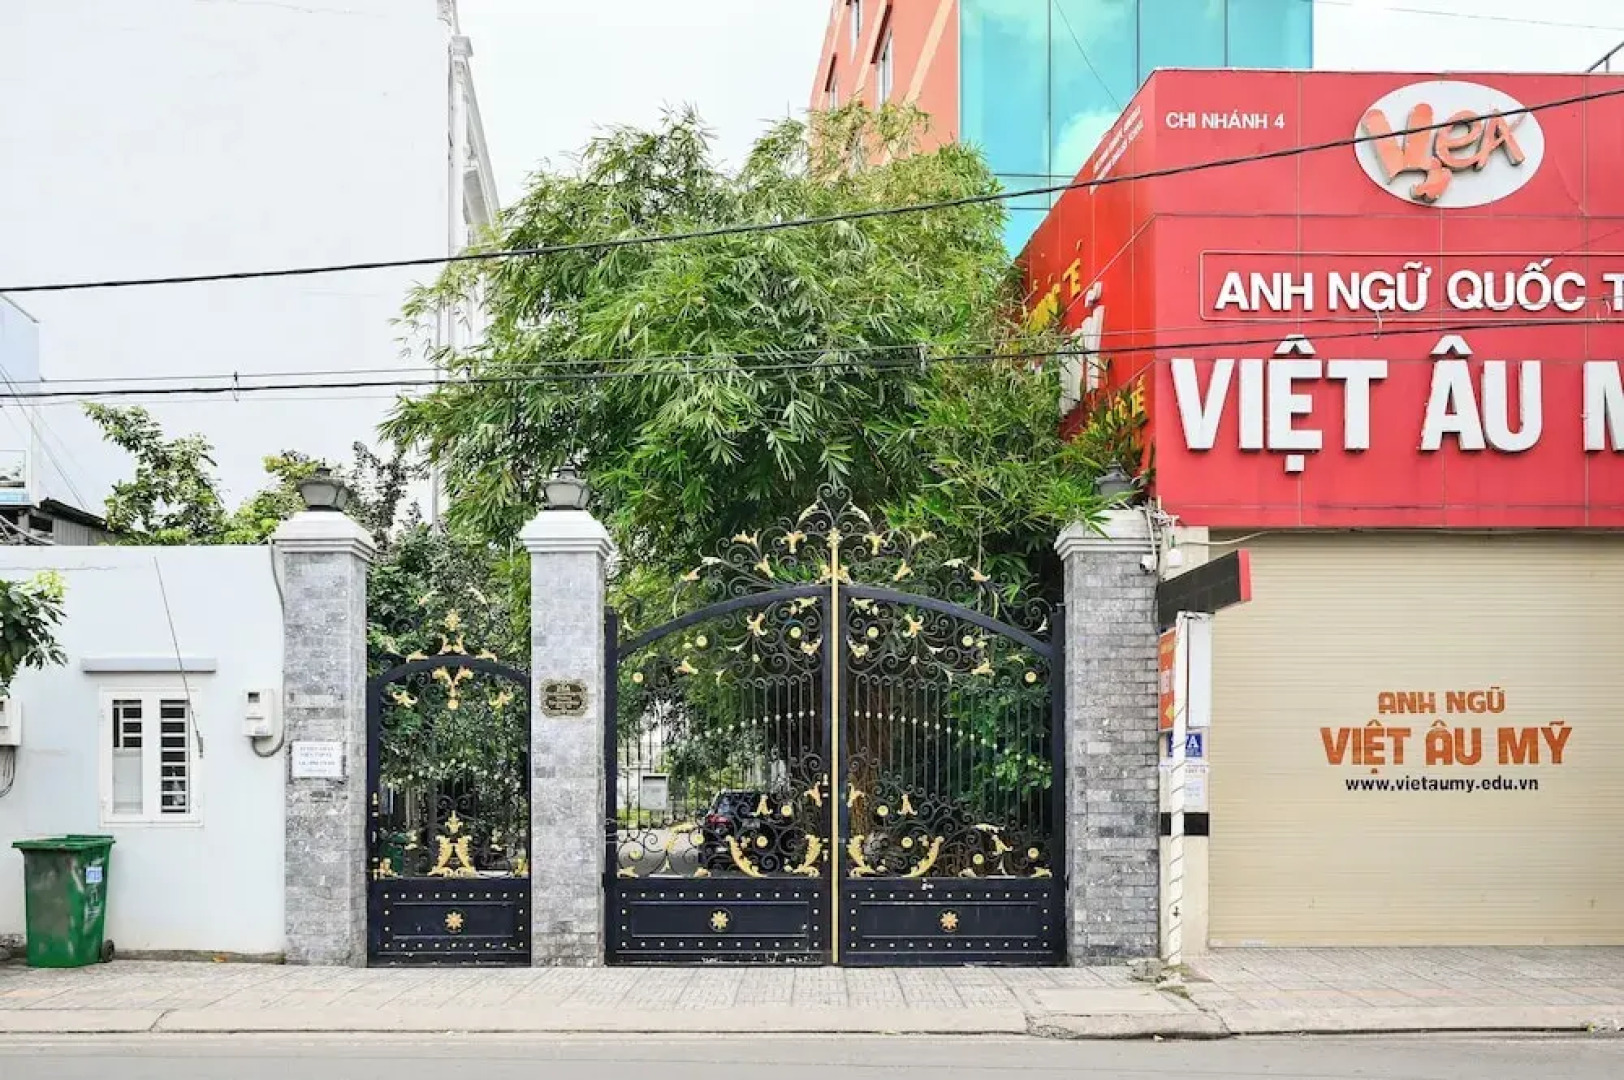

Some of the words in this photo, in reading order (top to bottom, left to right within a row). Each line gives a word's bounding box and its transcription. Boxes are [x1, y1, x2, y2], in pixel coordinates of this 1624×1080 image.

[1165, 111, 1197, 129] CHI
[1201, 109, 1268, 129] NHÁNH
[1273, 113, 1286, 129] 4
[1214, 272, 1314, 311] ANH
[1328, 261, 1432, 312] NGỮ
[1446, 257, 1586, 311] QUỐC
[1170, 335, 1388, 473] VIỆT
[1420, 335, 1542, 451] ÂU
[1377, 691, 1436, 714] ANH
[1446, 686, 1505, 714] NGỮ
[1320, 719, 1412, 774] VIỆT
[1425, 719, 1482, 766] ÂU
[1497, 720, 1573, 766] MỸ
[1345, 774, 1540, 794] www.vietaumy.edu.vn
